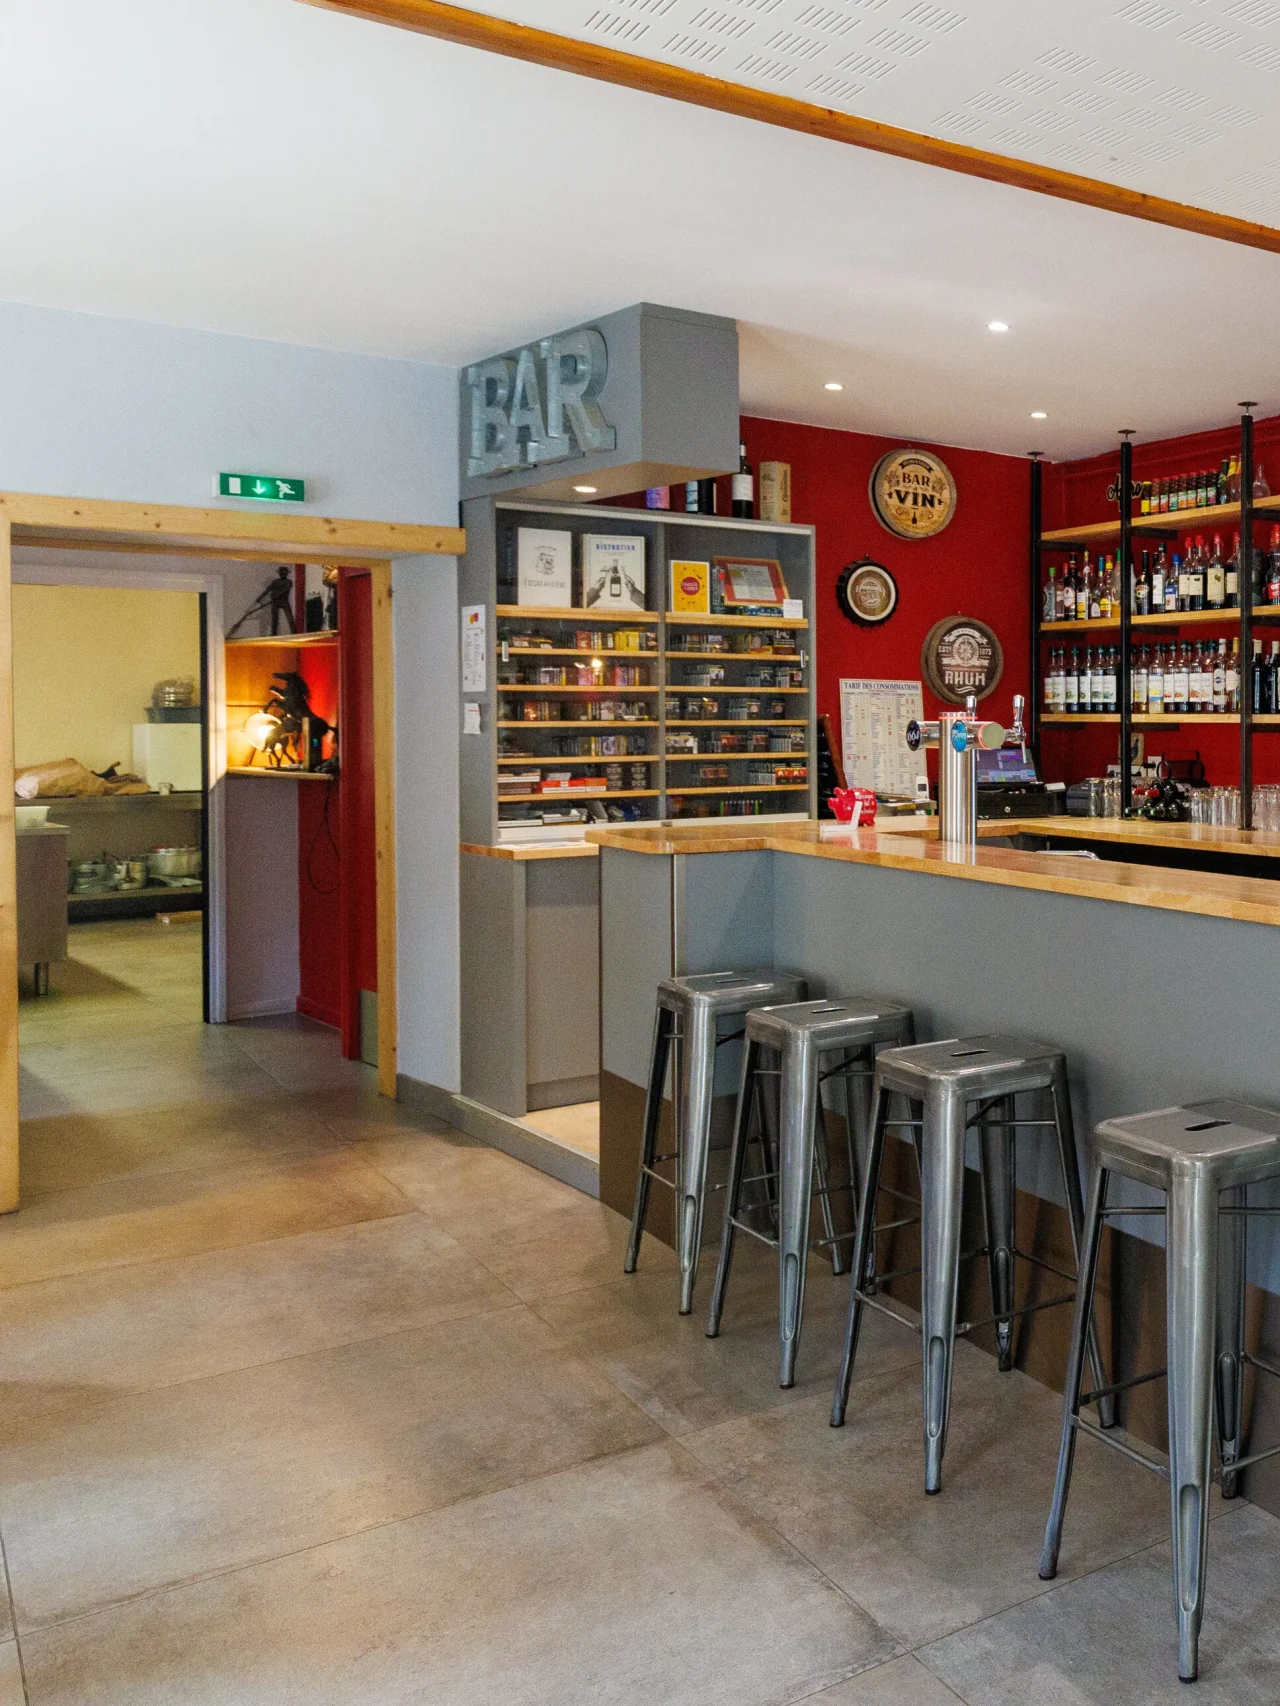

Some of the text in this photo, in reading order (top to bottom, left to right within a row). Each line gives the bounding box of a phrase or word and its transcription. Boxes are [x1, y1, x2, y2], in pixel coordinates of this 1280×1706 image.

[467, 329, 617, 479] BAR
[902, 472, 930, 487] BAR
[894, 489, 936, 509] VIN
[595, 543, 636, 551] BISTROTIER
[945, 671, 986, 686] RHUM
[862, 682, 873, 690] DES
[873, 683, 919, 691] CONSOMMATIONS
